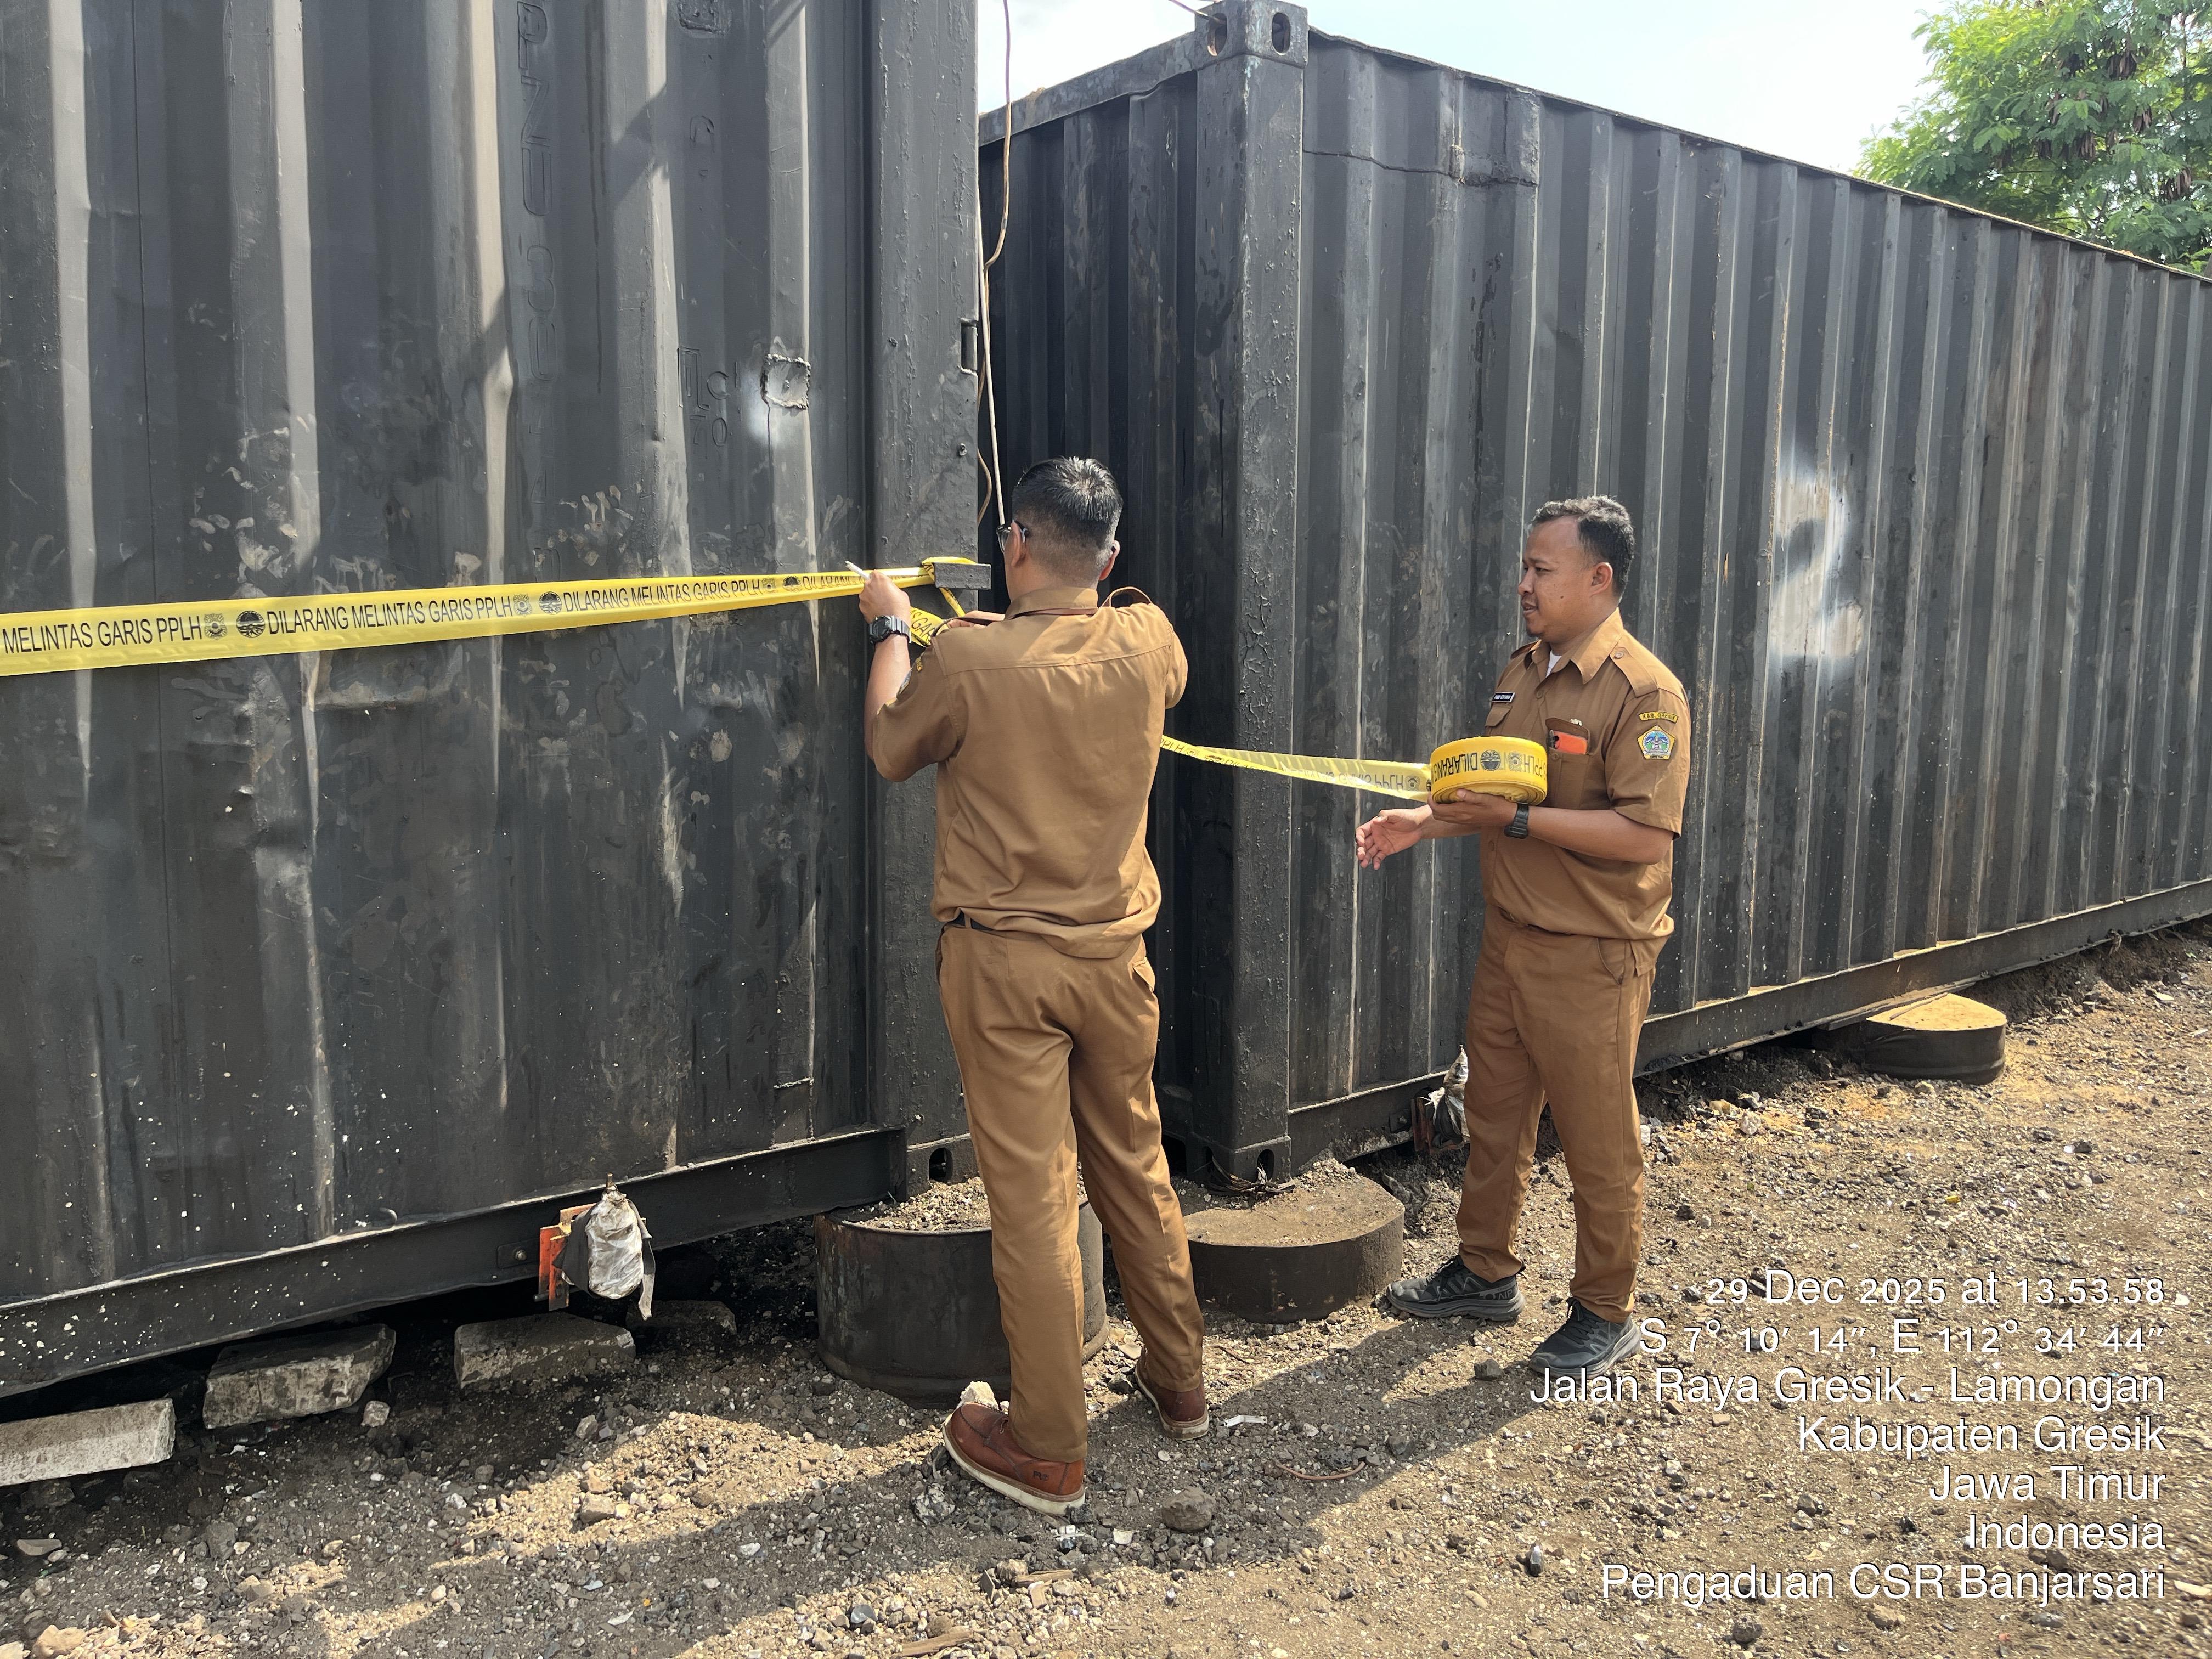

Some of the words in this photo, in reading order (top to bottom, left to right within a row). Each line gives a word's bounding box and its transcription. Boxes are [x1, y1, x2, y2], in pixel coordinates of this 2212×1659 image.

[2, 622, 93, 653] MELINTAS
[98, 618, 153, 646] GARIS
[156, 615, 202, 642] PPLH
[267, 606, 348, 634] DILARANG
[352, 601, 425, 629] MELINTAS
[429, 598, 473, 623] GARIS
[476, 596, 513, 619] PPLH
[563, 588, 629, 612] DILARANG
[631, 583, 692, 607] MELINTAS
[693, 580, 730, 601] GARIS
[731, 579, 763, 597] PPLH
[1434, 752, 1478, 782] DILARANG
[1523, 753, 1543, 778] PPLH
